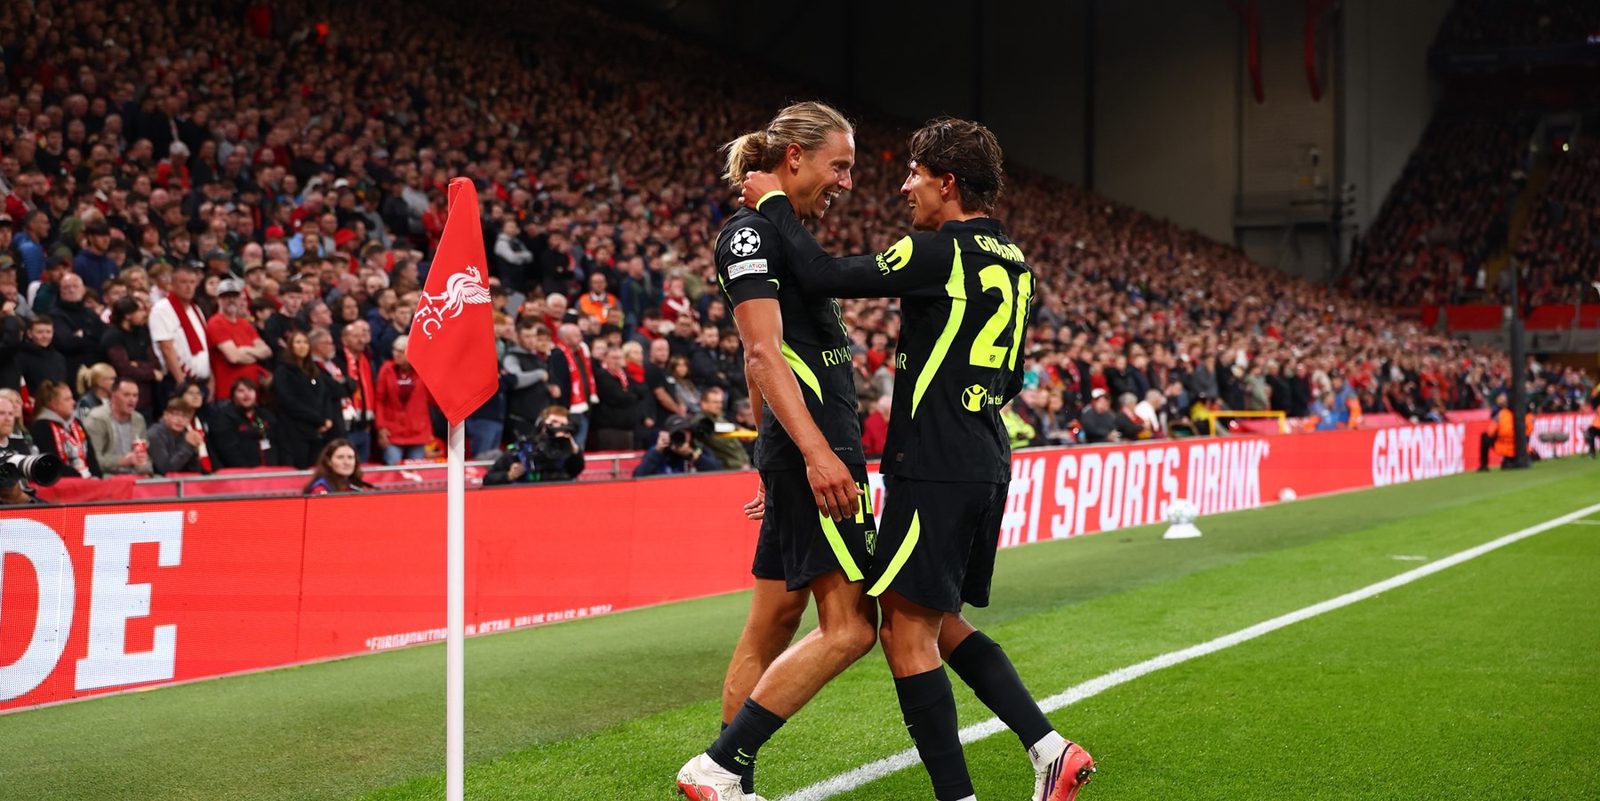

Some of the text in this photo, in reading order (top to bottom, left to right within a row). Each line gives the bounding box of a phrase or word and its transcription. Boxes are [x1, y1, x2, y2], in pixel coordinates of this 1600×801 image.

[1372, 422, 1465, 487] GATORADE
[1000, 458, 1046, 548] #1
[1051, 446, 1181, 540] SPORTS
